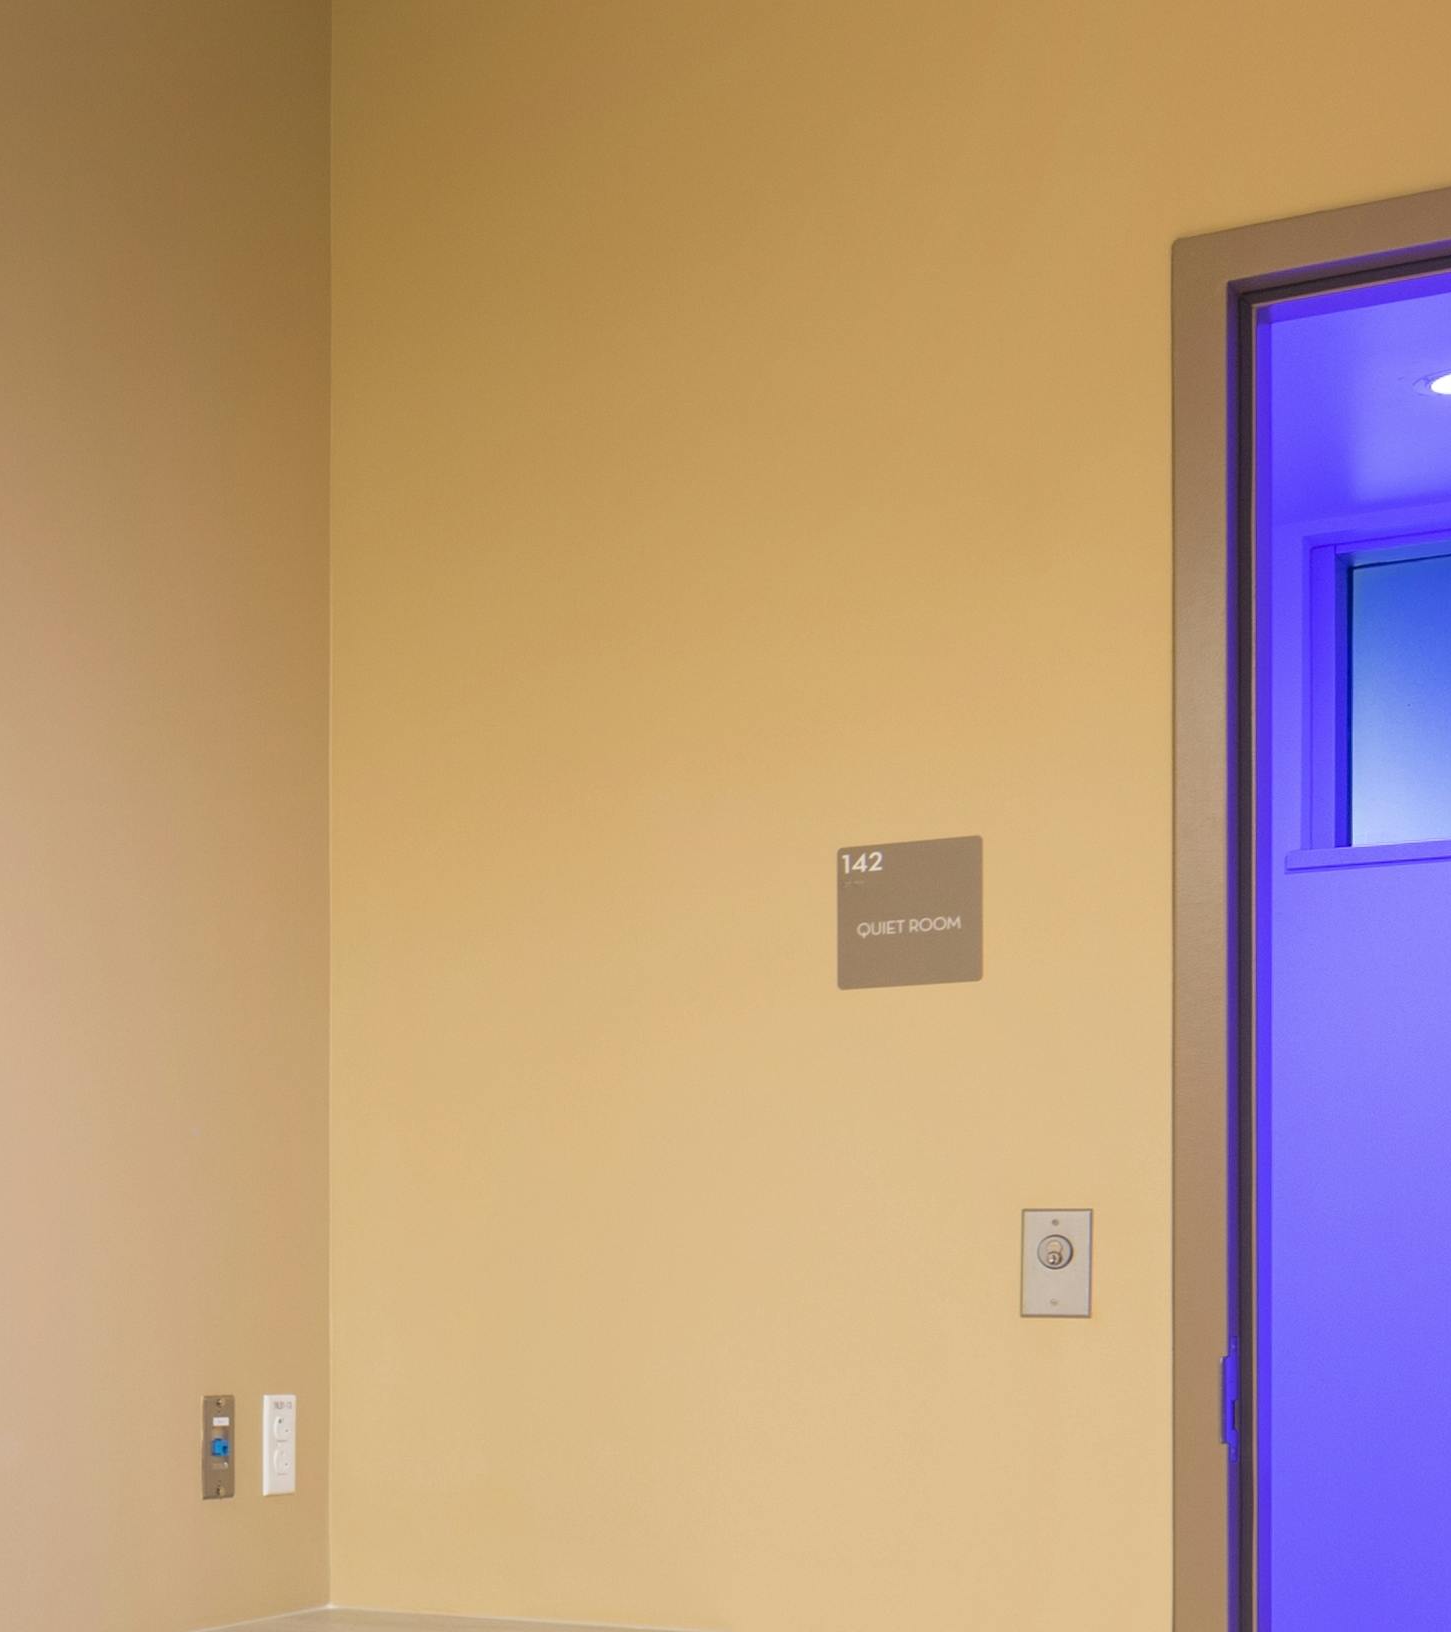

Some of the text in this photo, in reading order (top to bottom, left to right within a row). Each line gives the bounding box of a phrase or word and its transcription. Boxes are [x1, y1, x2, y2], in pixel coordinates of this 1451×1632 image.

[842, 851, 883, 874] 142
[857, 916, 962, 939] QUIET ROOM
